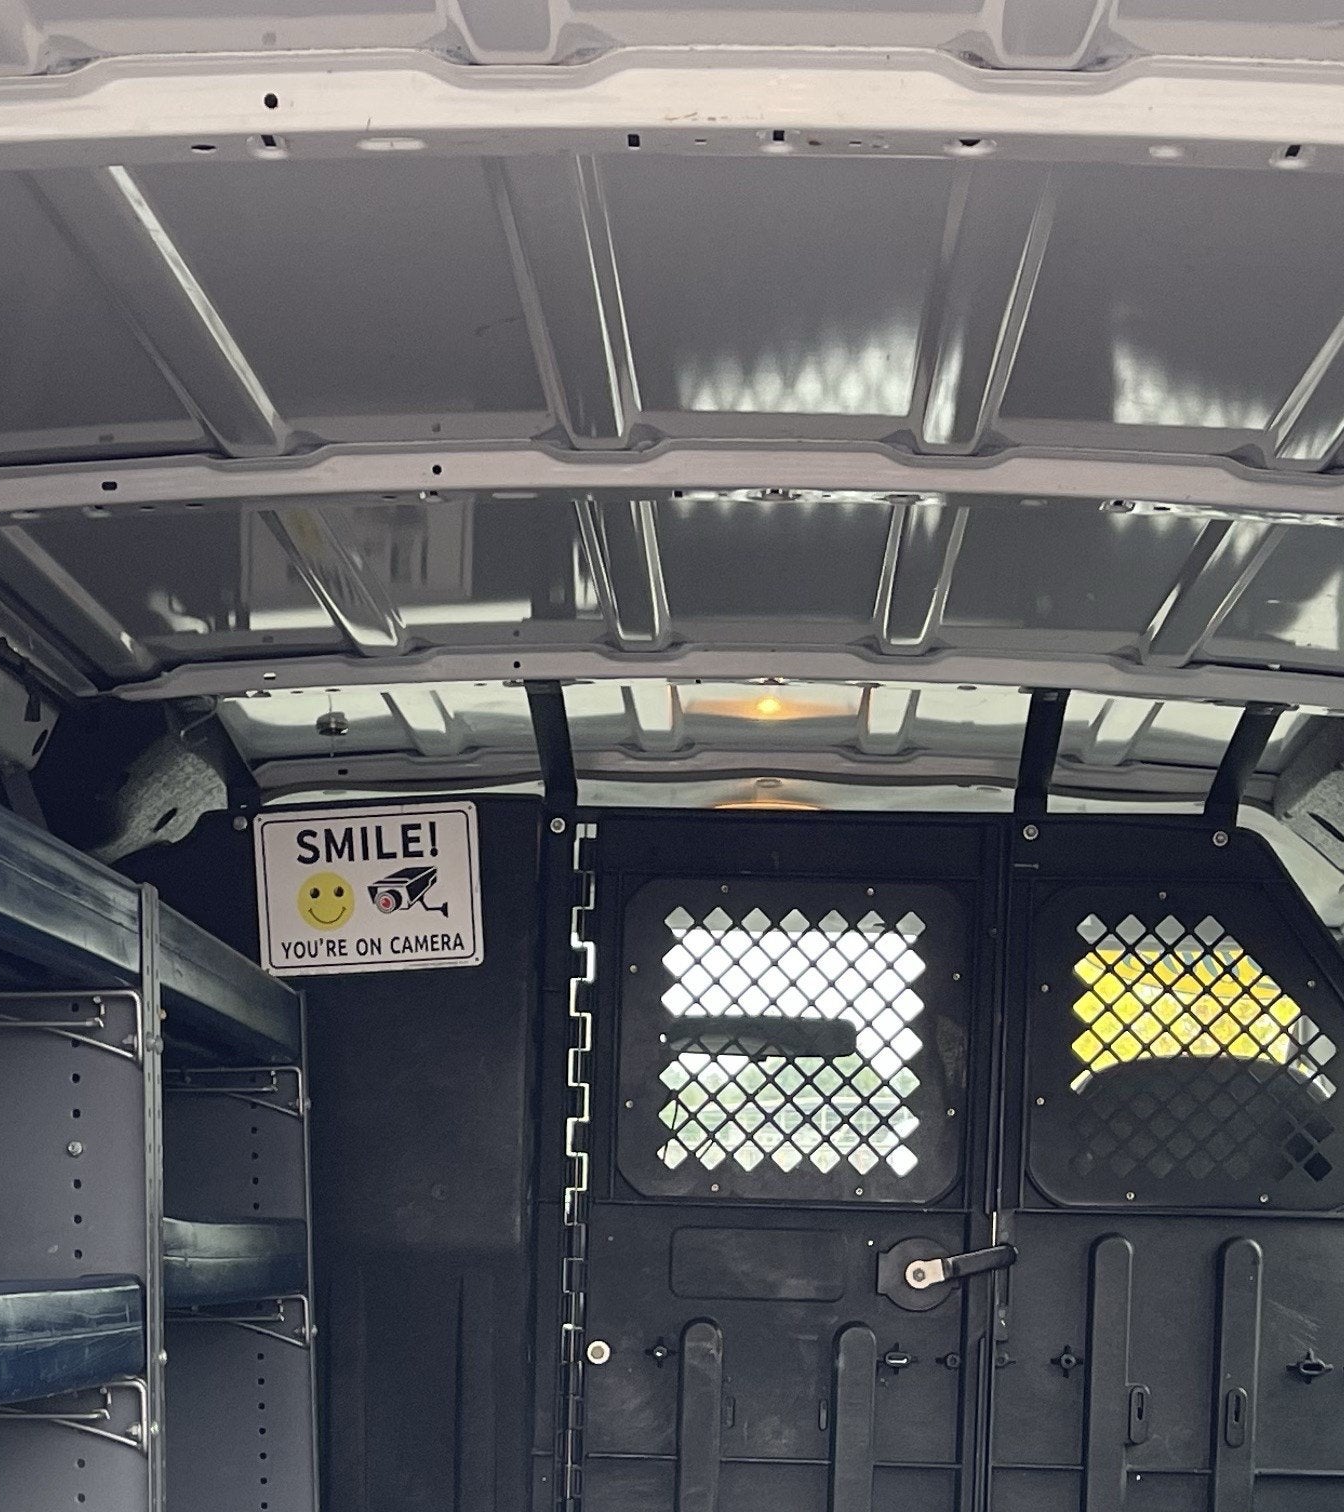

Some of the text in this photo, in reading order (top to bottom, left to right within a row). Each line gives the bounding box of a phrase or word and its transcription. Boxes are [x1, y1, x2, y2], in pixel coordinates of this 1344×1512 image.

[296, 821, 439, 865] SMILE!
[281, 932, 466, 960] YOU'RE ON CAMERA
